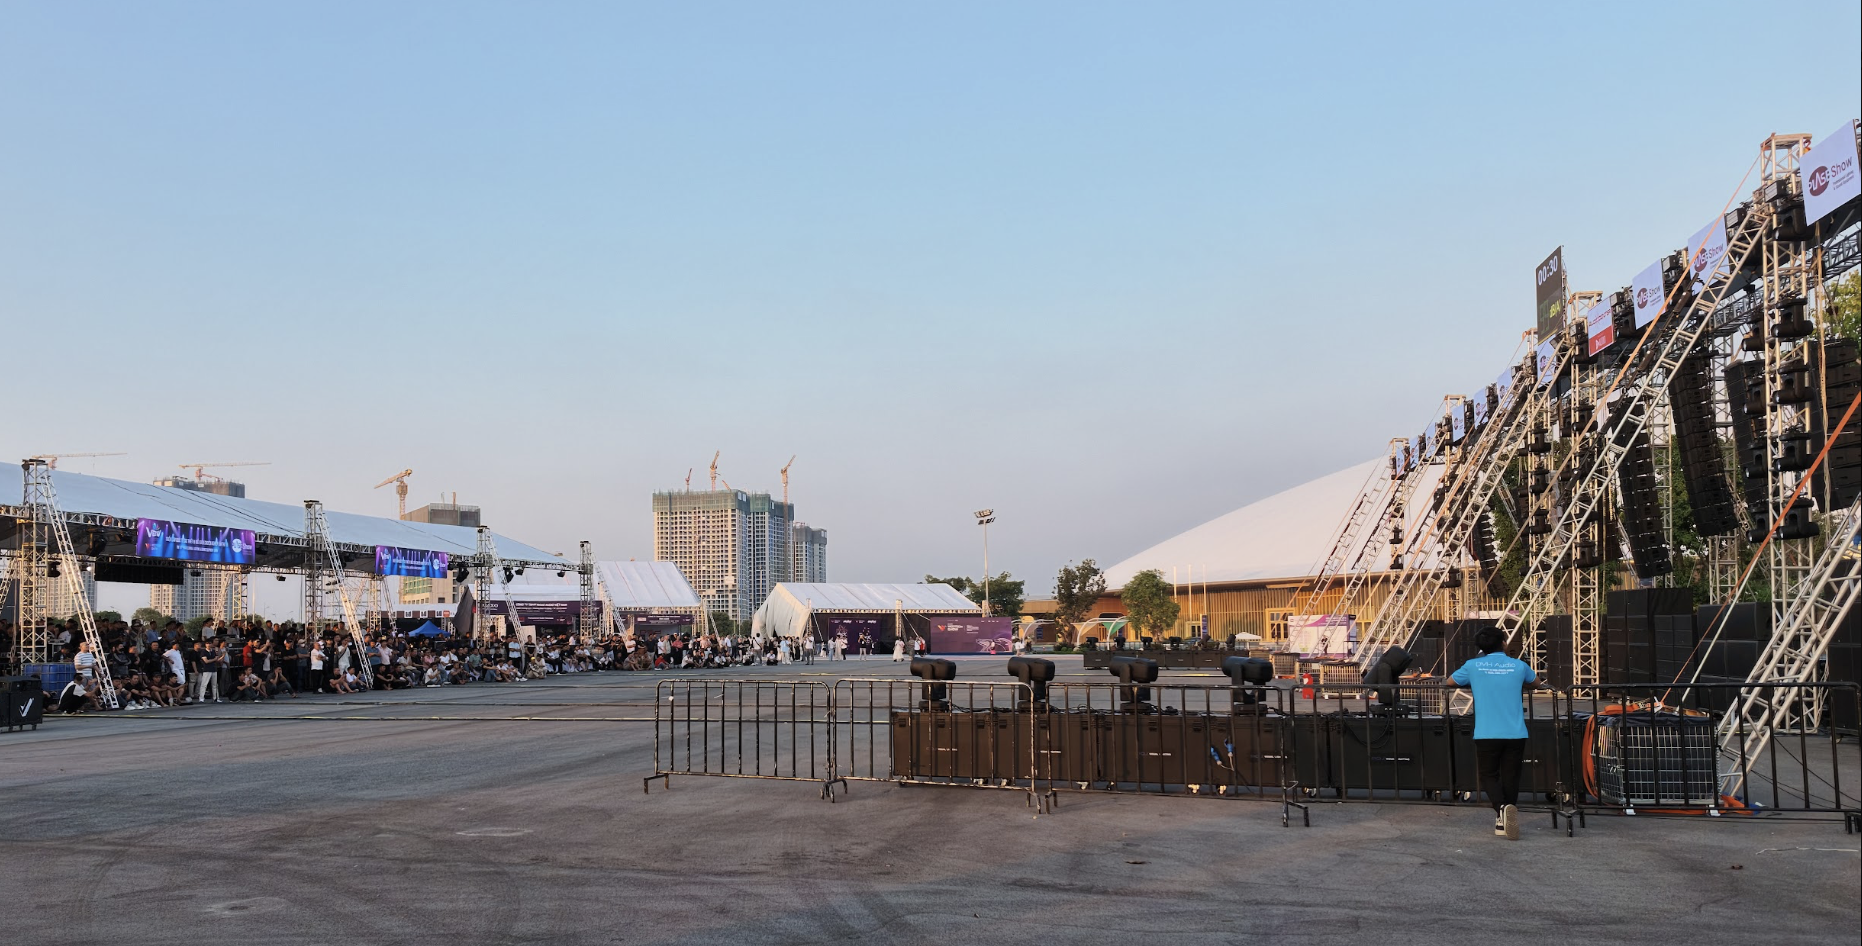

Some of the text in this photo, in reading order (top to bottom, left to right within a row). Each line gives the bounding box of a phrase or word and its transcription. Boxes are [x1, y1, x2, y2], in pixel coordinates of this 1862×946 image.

[1831, 157, 1852, 178] Show
[1708, 243, 1724, 259] Show
[1538, 255, 1558, 286] 00:30
